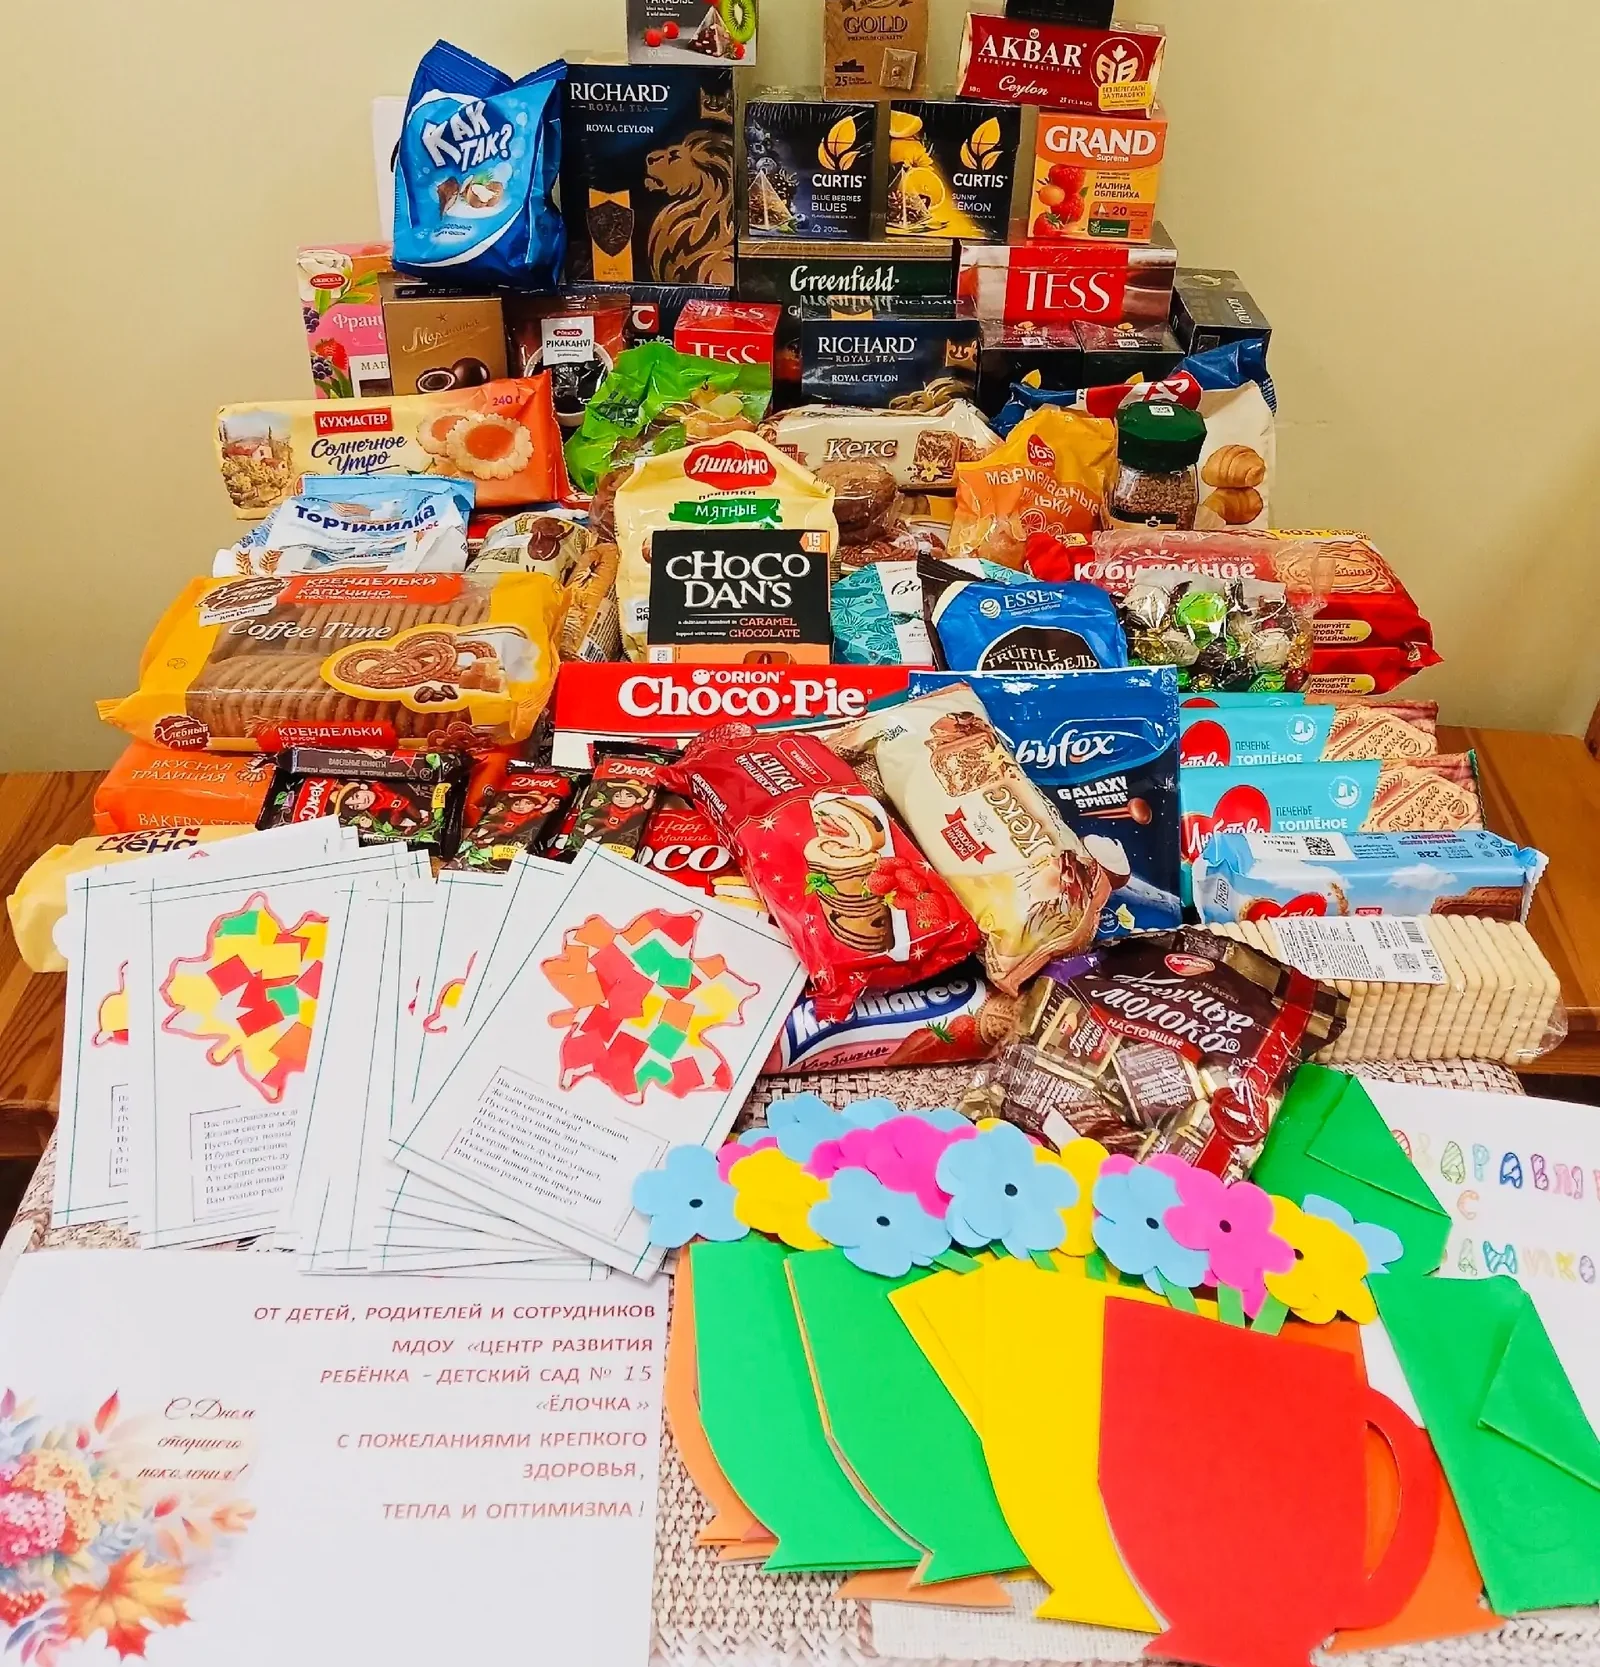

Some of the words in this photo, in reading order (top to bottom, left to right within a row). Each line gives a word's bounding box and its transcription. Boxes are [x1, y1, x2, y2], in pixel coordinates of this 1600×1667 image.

[843, 16, 908, 33] GOLD
[978, 34, 1083, 68] AKBAR
[835, 76, 848, 86] 25
[999, 75, 1049, 98] Ceylon
[570, 83, 668, 102] RICHARD
[589, 103, 624, 112] ROYAL
[629, 104, 650, 112] TEA
[422, 101, 490, 167] КАК
[586, 124, 614, 133] ROYAL
[617, 124, 654, 133] CEYLON
[459, 123, 514, 172] ТАК?
[1045, 125, 1157, 158] GRAND
[1096, 154, 1128, 163] Supreme
[812, 174, 864, 188] CURTIS
[953, 173, 1004, 188] CURTIS
[1094, 190, 1140, 199] ОБЛЕПИХА
[812, 203, 847, 213] BLUES
[1112, 206, 1127, 215] 20
[790, 264, 895, 292] Greenfield
[1019, 270, 1111, 313] TESS
[546, 339, 592, 348] PIKAKAHVI
[817, 336, 915, 354] RICHARD
[836, 355, 870, 363] ROYAL
[876, 355, 895, 363] TEA
[831, 374, 860, 382] ROYAL
[862, 374, 898, 382] CEYLON
[492, 395, 512, 406] 240
[319, 413, 387, 428] КУХМАСТЕР
[311, 435, 408, 459] Солнечное
[825, 439, 897, 462] Кекс
[1029, 441, 1054, 460] 365
[329, 453, 390, 474] Утро
[690, 454, 769, 475] ЯШКИНО
[698, 490, 756, 500] ПРЯНИКИ
[295, 504, 436, 533] Тортимилка
[695, 503, 757, 518] МЯТНЫЕ
[807, 533, 820, 545] 15
[665, 550, 810, 580] CHOCO
[304, 575, 438, 587] КРЕНДЕЛЬКИ
[298, 589, 391, 597] КАПУЧИНО
[684, 580, 793, 609] DAN'S
[1004, 589, 1063, 609] ESSEN
[228, 619, 316, 640] Coffee
[320, 622, 392, 639] Time
[740, 618, 797, 626] CARAMEL
[729, 629, 800, 638] CHOCOLATE
[986, 649, 1059, 668] TRUFFLE
[715, 670, 781, 684] ORION
[154, 725, 209, 742] Хлебный
[277, 726, 383, 737] КРЕНДЕЛЬКИ
[1235, 740, 1270, 751] ПЕЧЕНЬЕ
[151, 759, 233, 771] ВКУСНАЯ
[1235, 751, 1303, 764] ТОПЛЁНОЕ
[132, 769, 226, 783] ТРАДИЦИЯ
[608, 762, 655, 778] Джек
[511, 776, 558, 789] Джек
[1057, 776, 1128, 801] GALAXY
[1077, 792, 1127, 809] SPHERE
[1276, 805, 1313, 817] ПЕЧЕНЬЕ
[982, 786, 1055, 860] Кекс
[1278, 817, 1348, 830] ТОПЛЁНОЕ
[1091, 988, 1227, 1054] молоко
[1108, 1017, 1184, 1050] НАСТОЯЩИЕ
[1457, 1189, 1479, 1220] С
[253, 1306, 281, 1322] ОТ
[285, 1304, 356, 1323] ДЕТЕЙ,
[365, 1303, 483, 1321] РОДИТЕЛЕЙ
[491, 1306, 504, 1320] И
[512, 1304, 656, 1321] СОТРУДНИКОВ
[391, 1339, 455, 1356] МДОУ
[467, 1339, 544, 1355] «ЦЕНТР
[551, 1338, 653, 1353] РАЗВИТИЯ
[320, 1365, 410, 1384] РЕБЁНКА
[539, 1367, 580, 1384] САД
[589, 1366, 612, 1381] №
[624, 1365, 652, 1382] 15
[164, 1397, 192, 1420] С
[336, 1433, 350, 1449] С
[357, 1432, 531, 1449] ПОЖЕЛАНИЯМИ
[539, 1431, 648, 1448] КРЕПКОГО
[522, 1461, 645, 1481] ЗДОРОВЬЯ,
[382, 1503, 451, 1520] ТЕПЛА
[461, 1503, 477, 1518] И
[486, 1500, 645, 1519] ОПТИМИЗМА!
